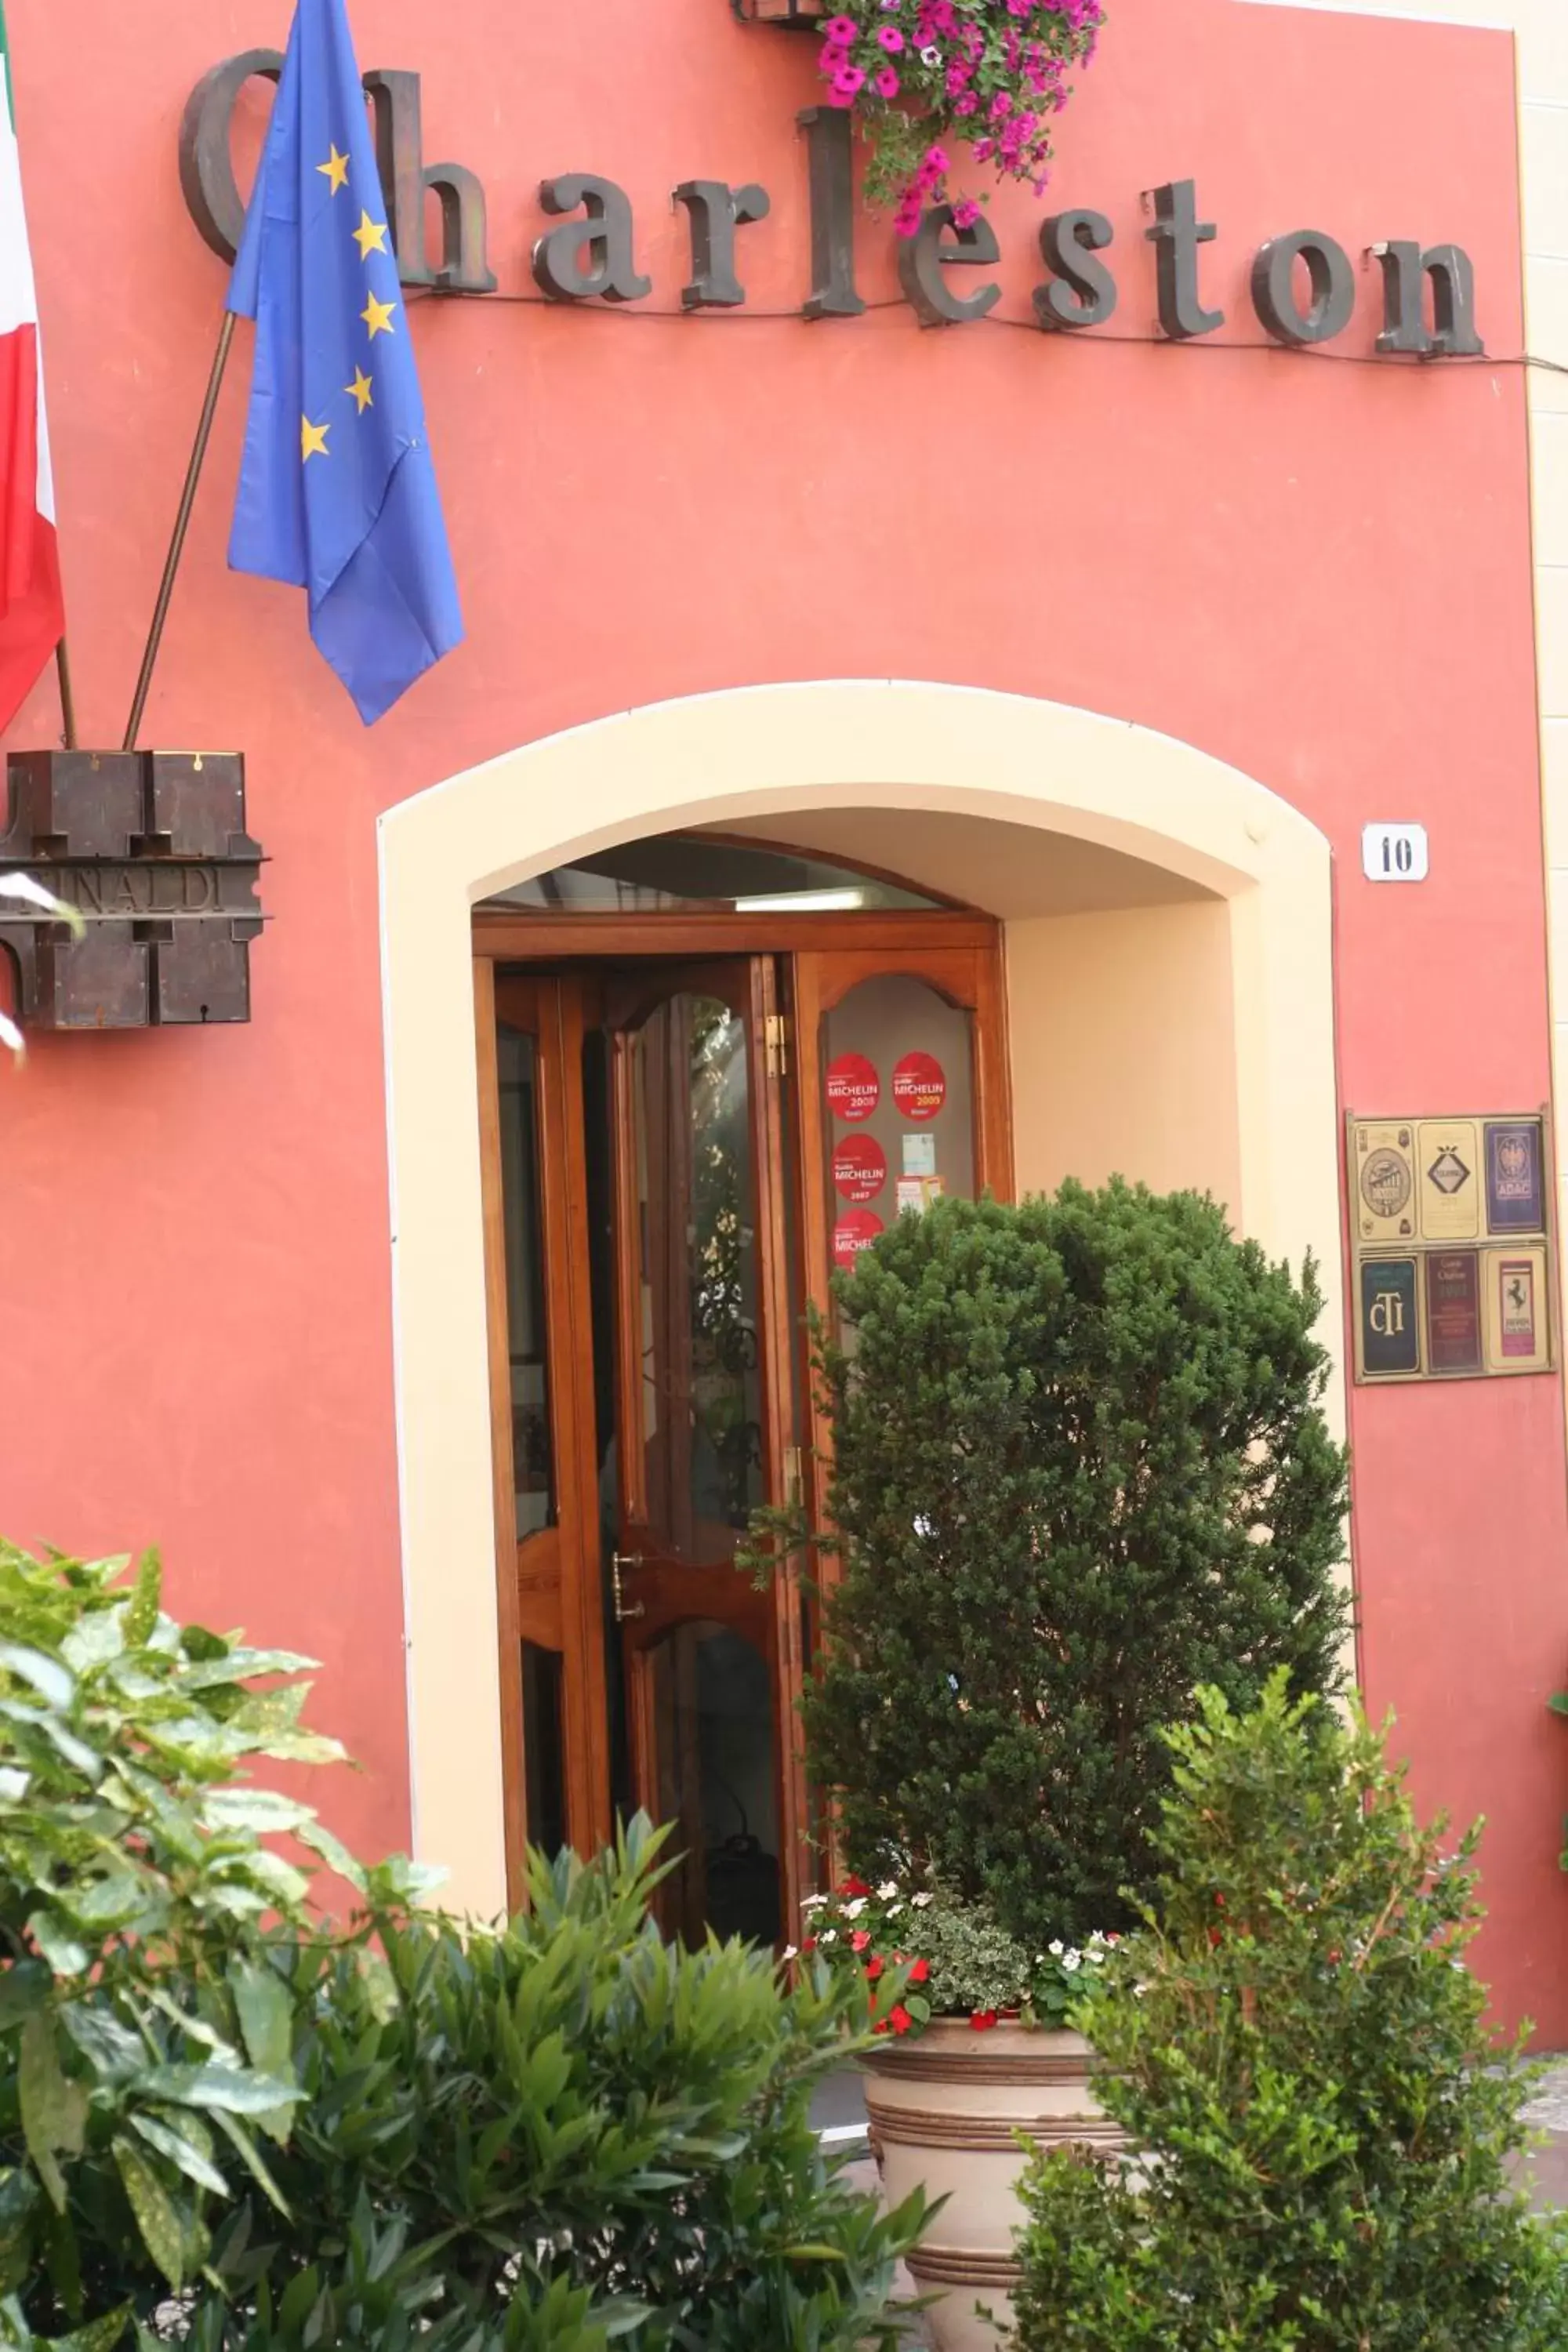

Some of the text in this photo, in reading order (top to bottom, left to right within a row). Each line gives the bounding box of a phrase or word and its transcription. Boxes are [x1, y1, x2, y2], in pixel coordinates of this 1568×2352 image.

[179, 48, 1484, 358] Charleston
[1382, 836, 1412, 873] 10
[17, 867, 225, 913] INALDI
[828, 1084, 877, 1097] MICHELIN
[895, 1083, 943, 1095] MICHELIN
[835, 1168, 884, 1180] MICHELIN
